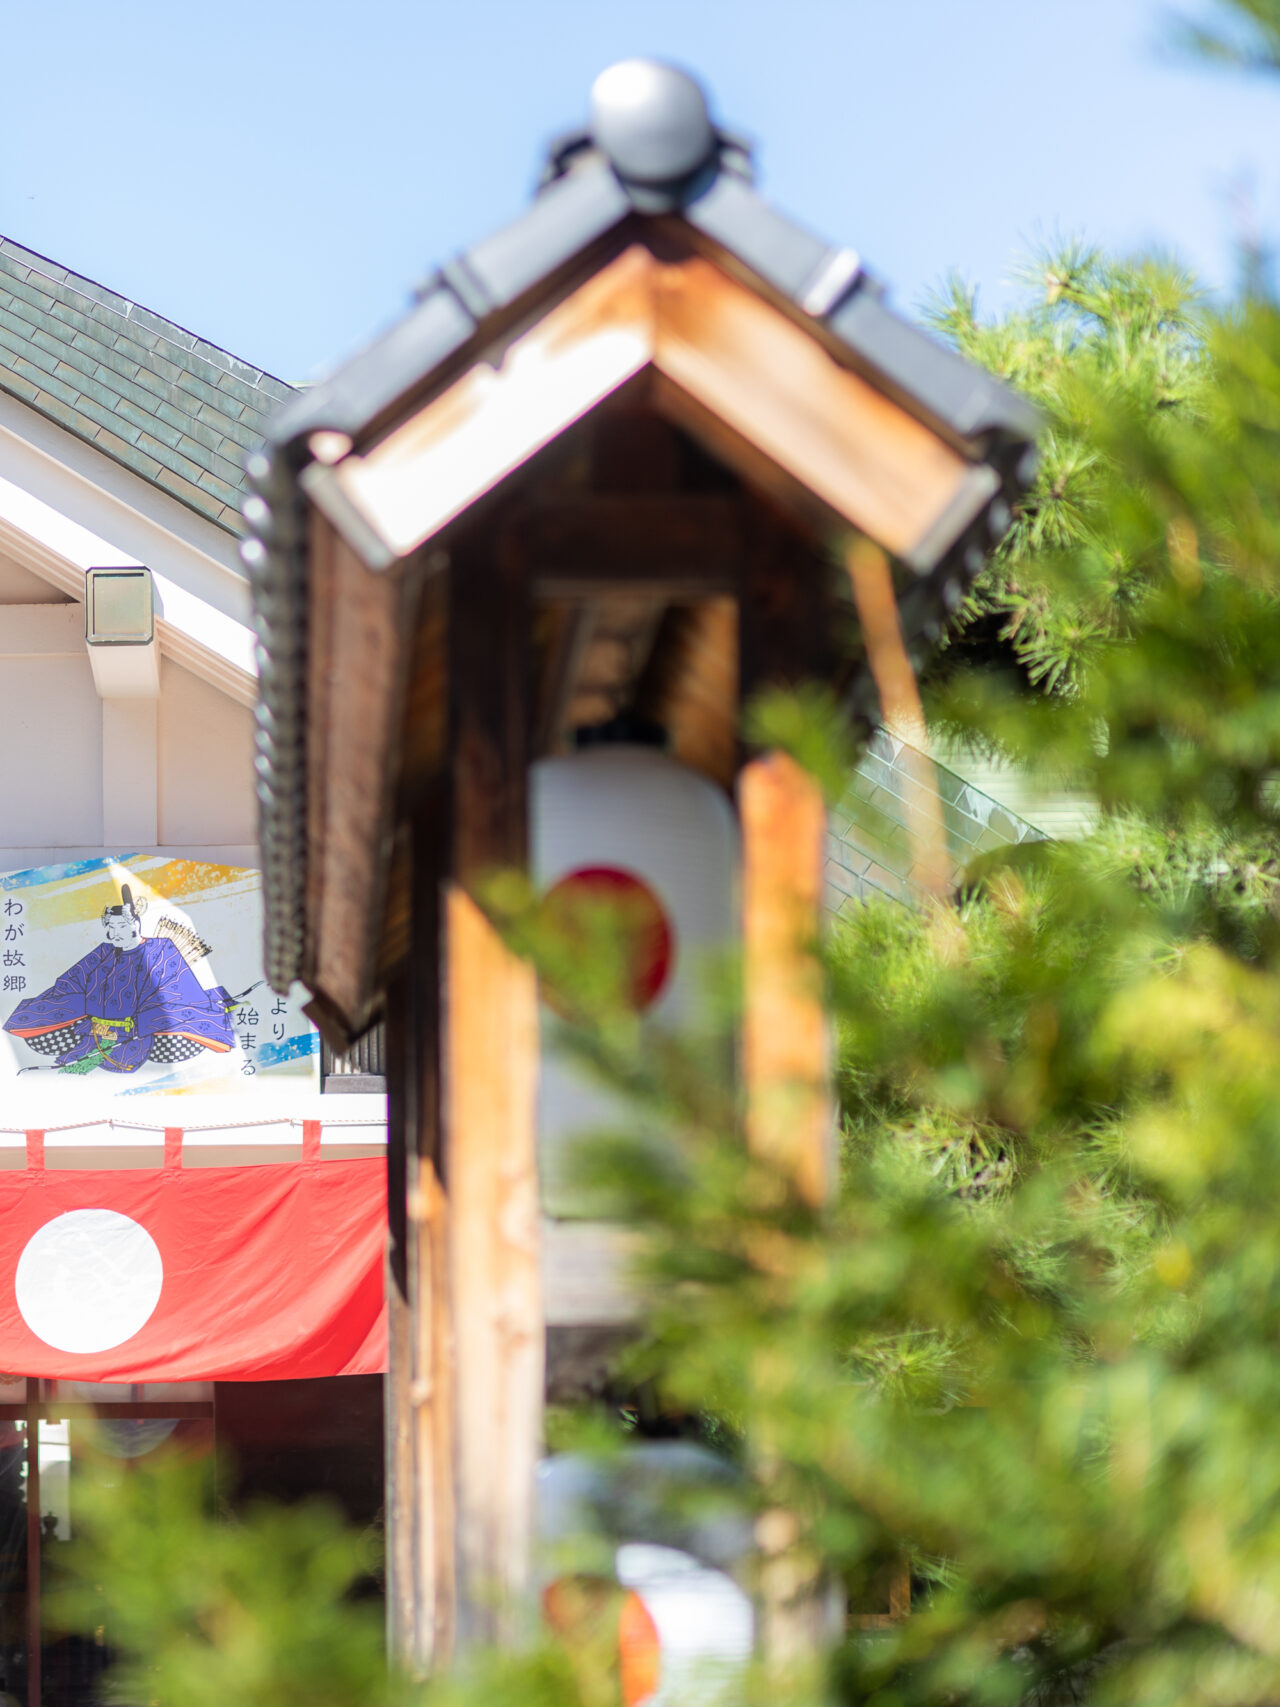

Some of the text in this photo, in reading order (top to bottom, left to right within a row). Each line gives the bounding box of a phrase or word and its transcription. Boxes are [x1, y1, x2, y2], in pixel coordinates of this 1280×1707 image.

[3, 898, 27, 992] わが故郷
[236, 1007, 260, 1076] 始まる
[269, 992, 288, 1041] より
